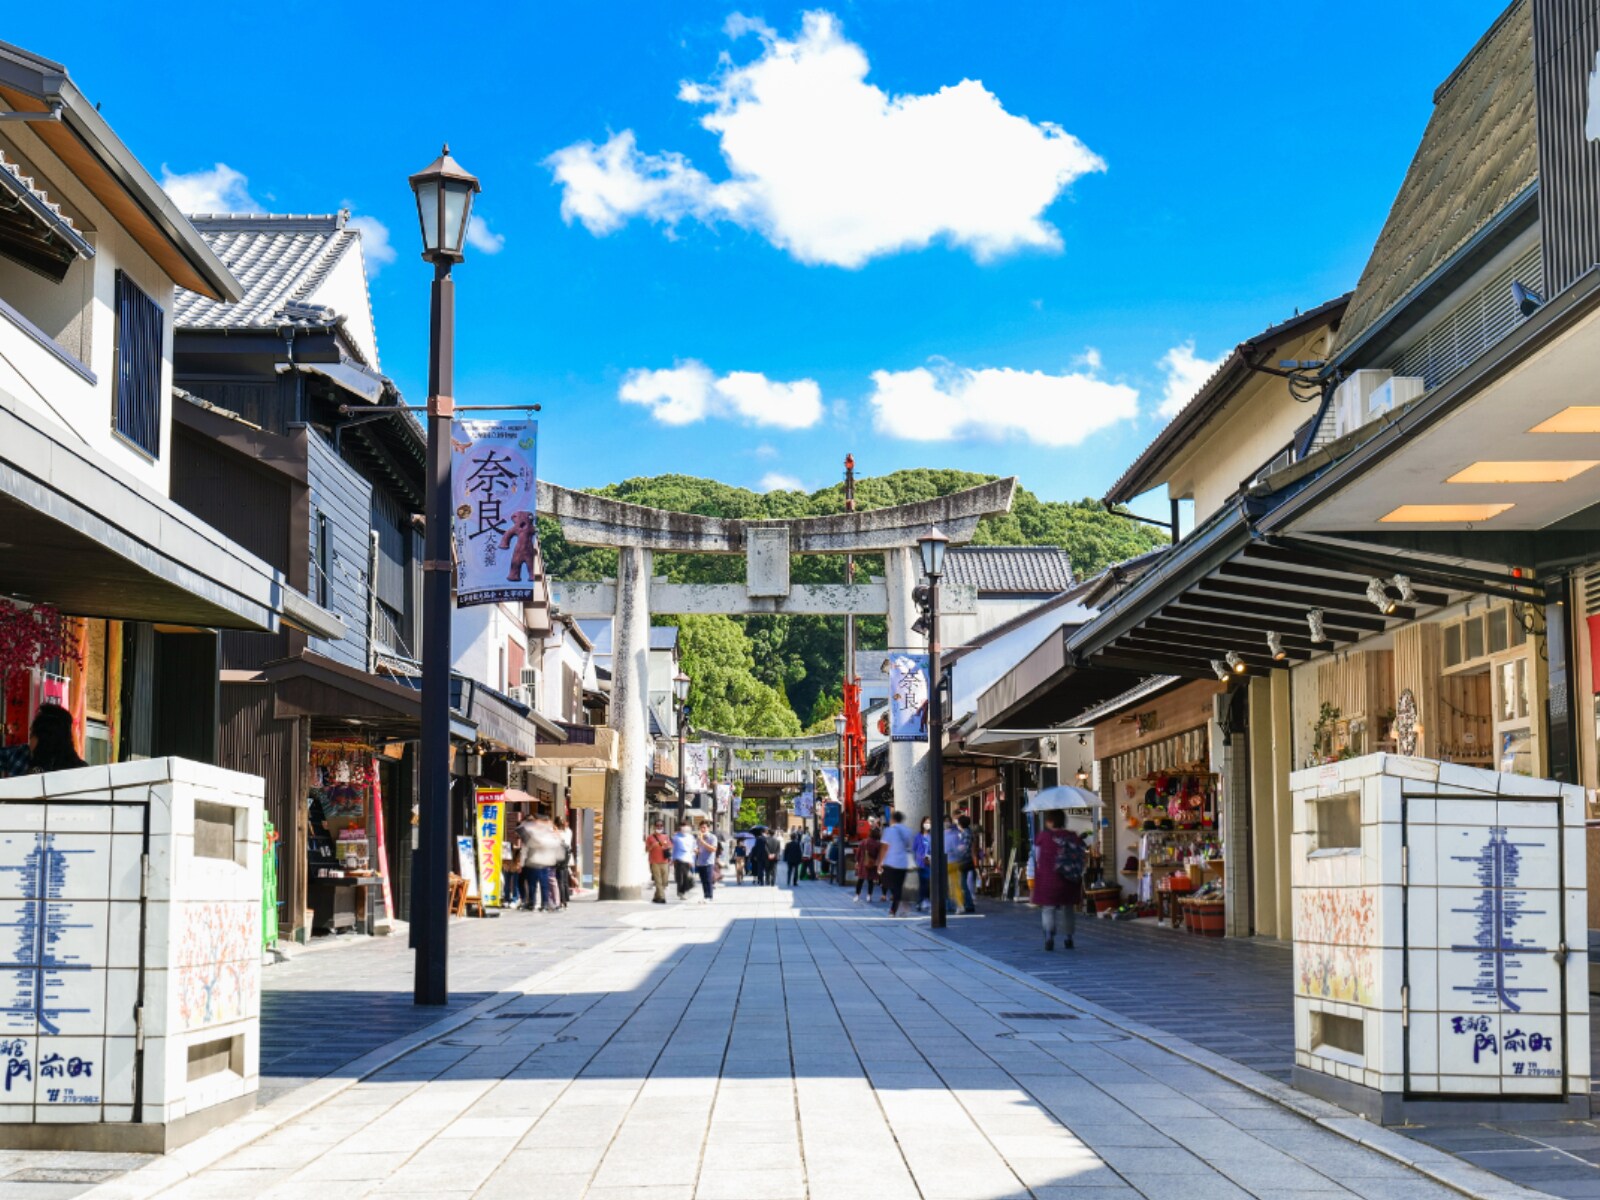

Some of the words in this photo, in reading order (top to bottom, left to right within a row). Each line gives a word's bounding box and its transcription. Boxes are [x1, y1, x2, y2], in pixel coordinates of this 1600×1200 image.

[466, 450, 519, 540] 奈良
[898, 668, 922, 711] 奈良
[481, 805, 498, 882] 新作マスク
[1473, 1028, 1552, 1064] 門前町
[5, 1053, 94, 1092] 門前町
